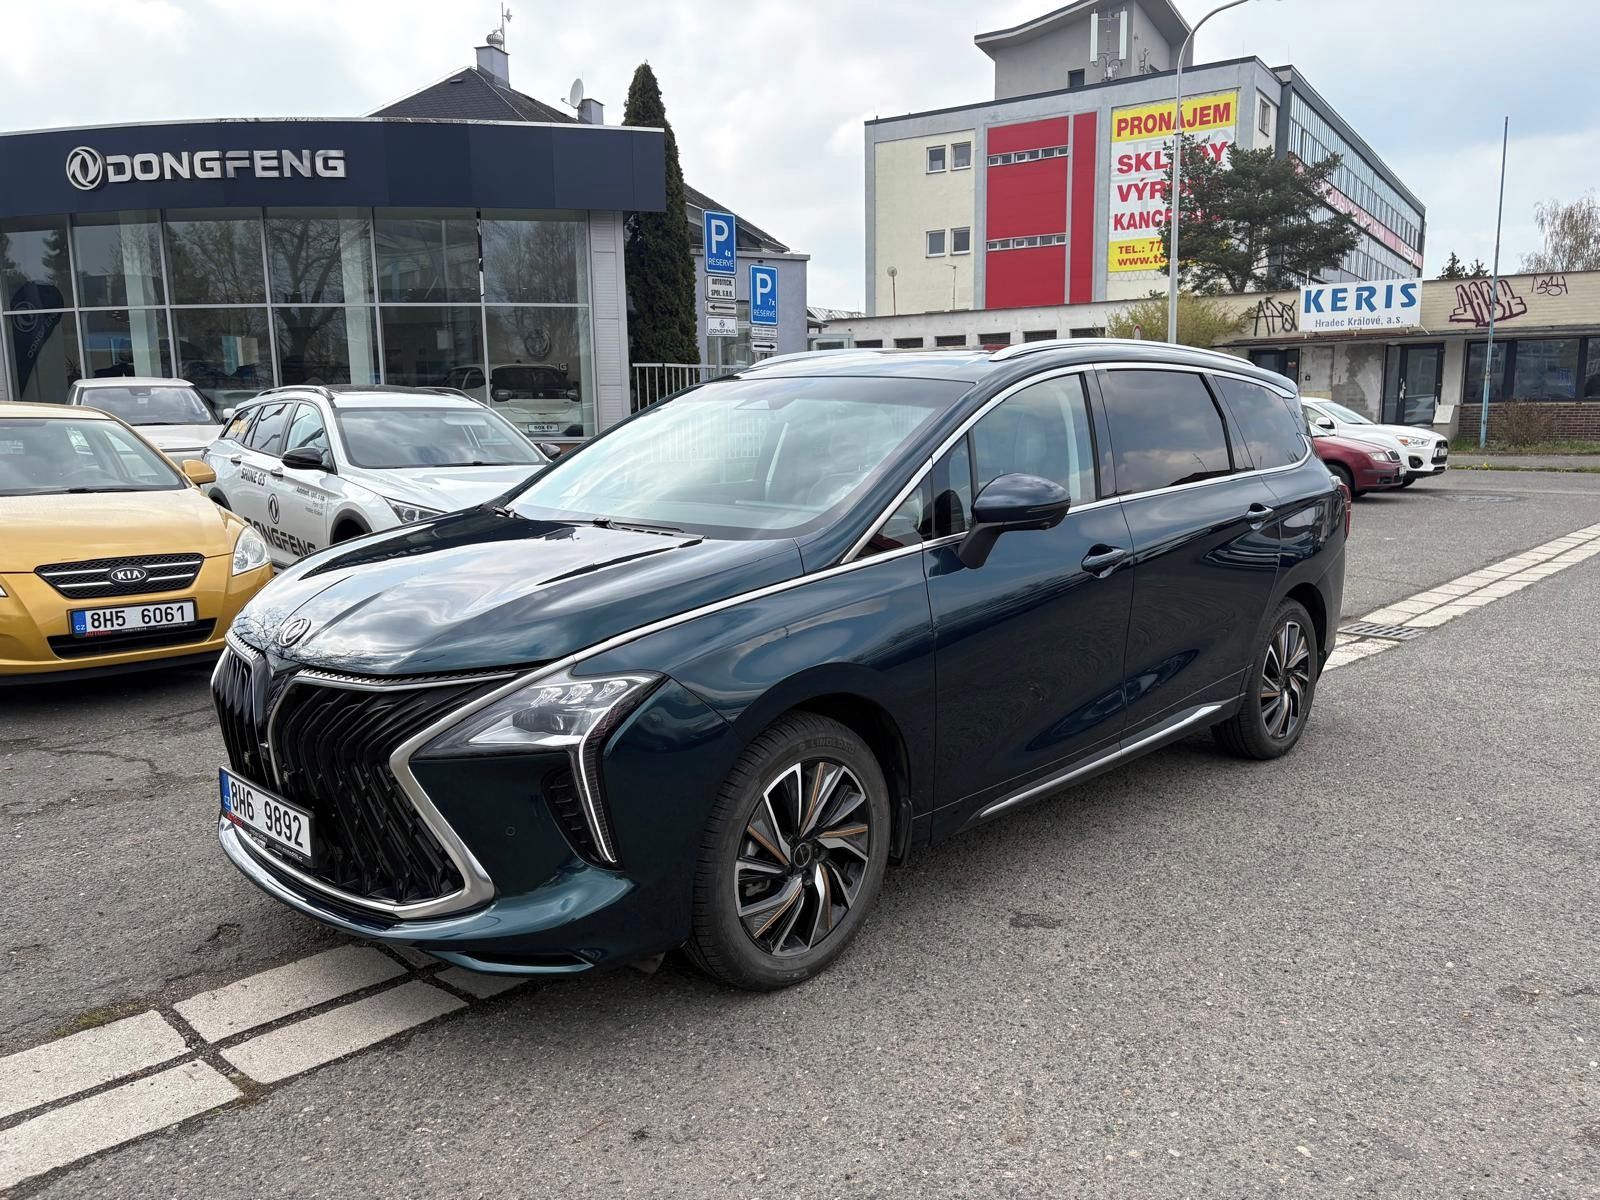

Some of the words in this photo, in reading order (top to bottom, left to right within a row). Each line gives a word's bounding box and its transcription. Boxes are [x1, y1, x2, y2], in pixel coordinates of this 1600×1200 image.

[106, 149, 347, 183] DONGFENG
[1116, 141, 1229, 175] SKLY
[711, 219, 729, 254] P
[1118, 245, 1145, 254] TEL.:
[1149, 240, 1163, 253] 77
[1118, 254, 1166, 266] www.tc
[756, 272, 772, 305] P
[1304, 283, 1417, 313] KERIS
[1315, 319, 1345, 328] Hradec
[1347, 316, 1384, 328] Králové,
[1386, 316, 1404, 325] a.s.
[116, 570, 141, 580] KIA
[90, 610, 126, 629] 8H5
[141, 605, 185, 625] 6061
[230, 781, 255, 821] 8H6
[264, 800, 303, 848] 9892
